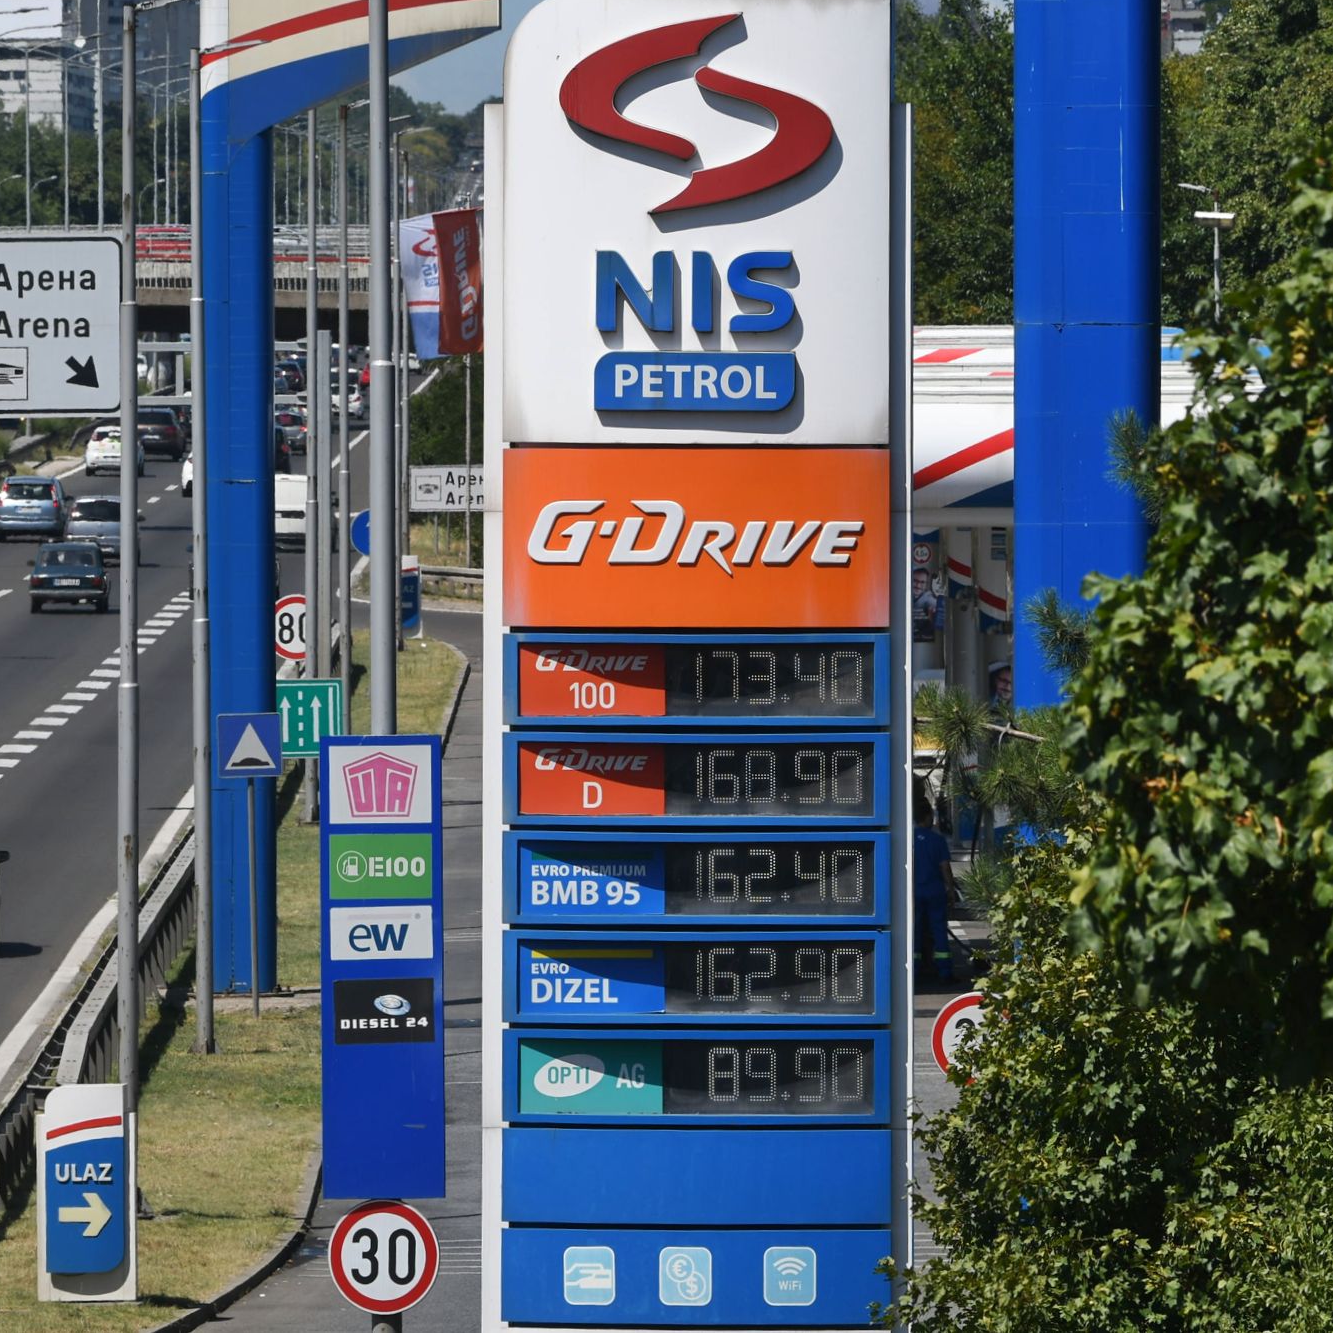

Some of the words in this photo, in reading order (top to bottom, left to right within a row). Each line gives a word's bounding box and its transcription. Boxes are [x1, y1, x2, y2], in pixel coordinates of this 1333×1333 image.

[595, 250, 796, 332] NIS
[614, 364, 777, 399] PETROL
[445, 471, 484, 488] Арен
[445, 492, 484, 505] Aren
[569, 682, 616, 709] 100
[348, 756, 414, 813] UTA
[582, 782, 603, 808] D
[368, 857, 426, 877] E100
[531, 865, 570, 877] EVRO
[572, 865, 646, 877] PREMIJUM
[531, 880, 600, 905] BMB
[606, 880, 641, 905] 95
[349, 924, 409, 952] ew
[531, 963, 570, 974] EVRO
[531, 979, 618, 1003] DIZEL
[340, 1018, 399, 1029] DIESEL
[406, 1017, 428, 1027] 24
[547, 1067, 590, 1084] OPTI
[617, 1064, 645, 1089] AG
[55, 1163, 112, 1182] ULAZ
[351, 1227, 416, 1285] 30
[778, 1280, 802, 1291] WiFi
